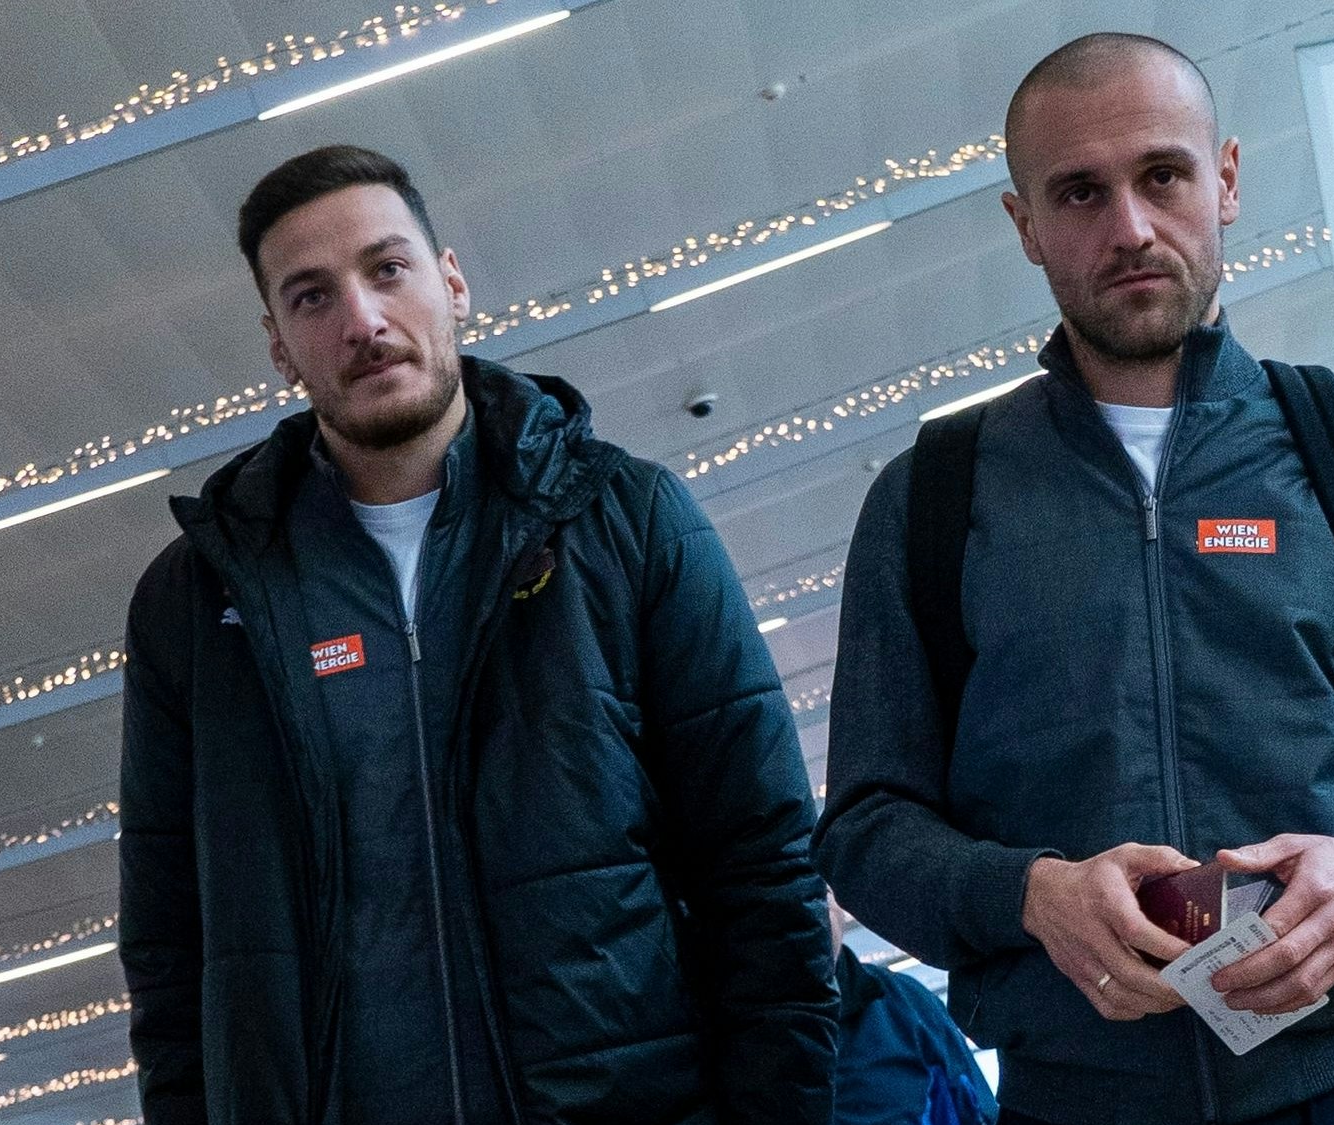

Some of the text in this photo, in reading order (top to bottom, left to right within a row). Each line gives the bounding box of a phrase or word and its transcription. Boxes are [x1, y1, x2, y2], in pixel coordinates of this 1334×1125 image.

[1216, 524, 1258, 535] WIEN
[1204, 536, 1269, 548] ENERGIE
[311, 643, 347, 659] WIEN
